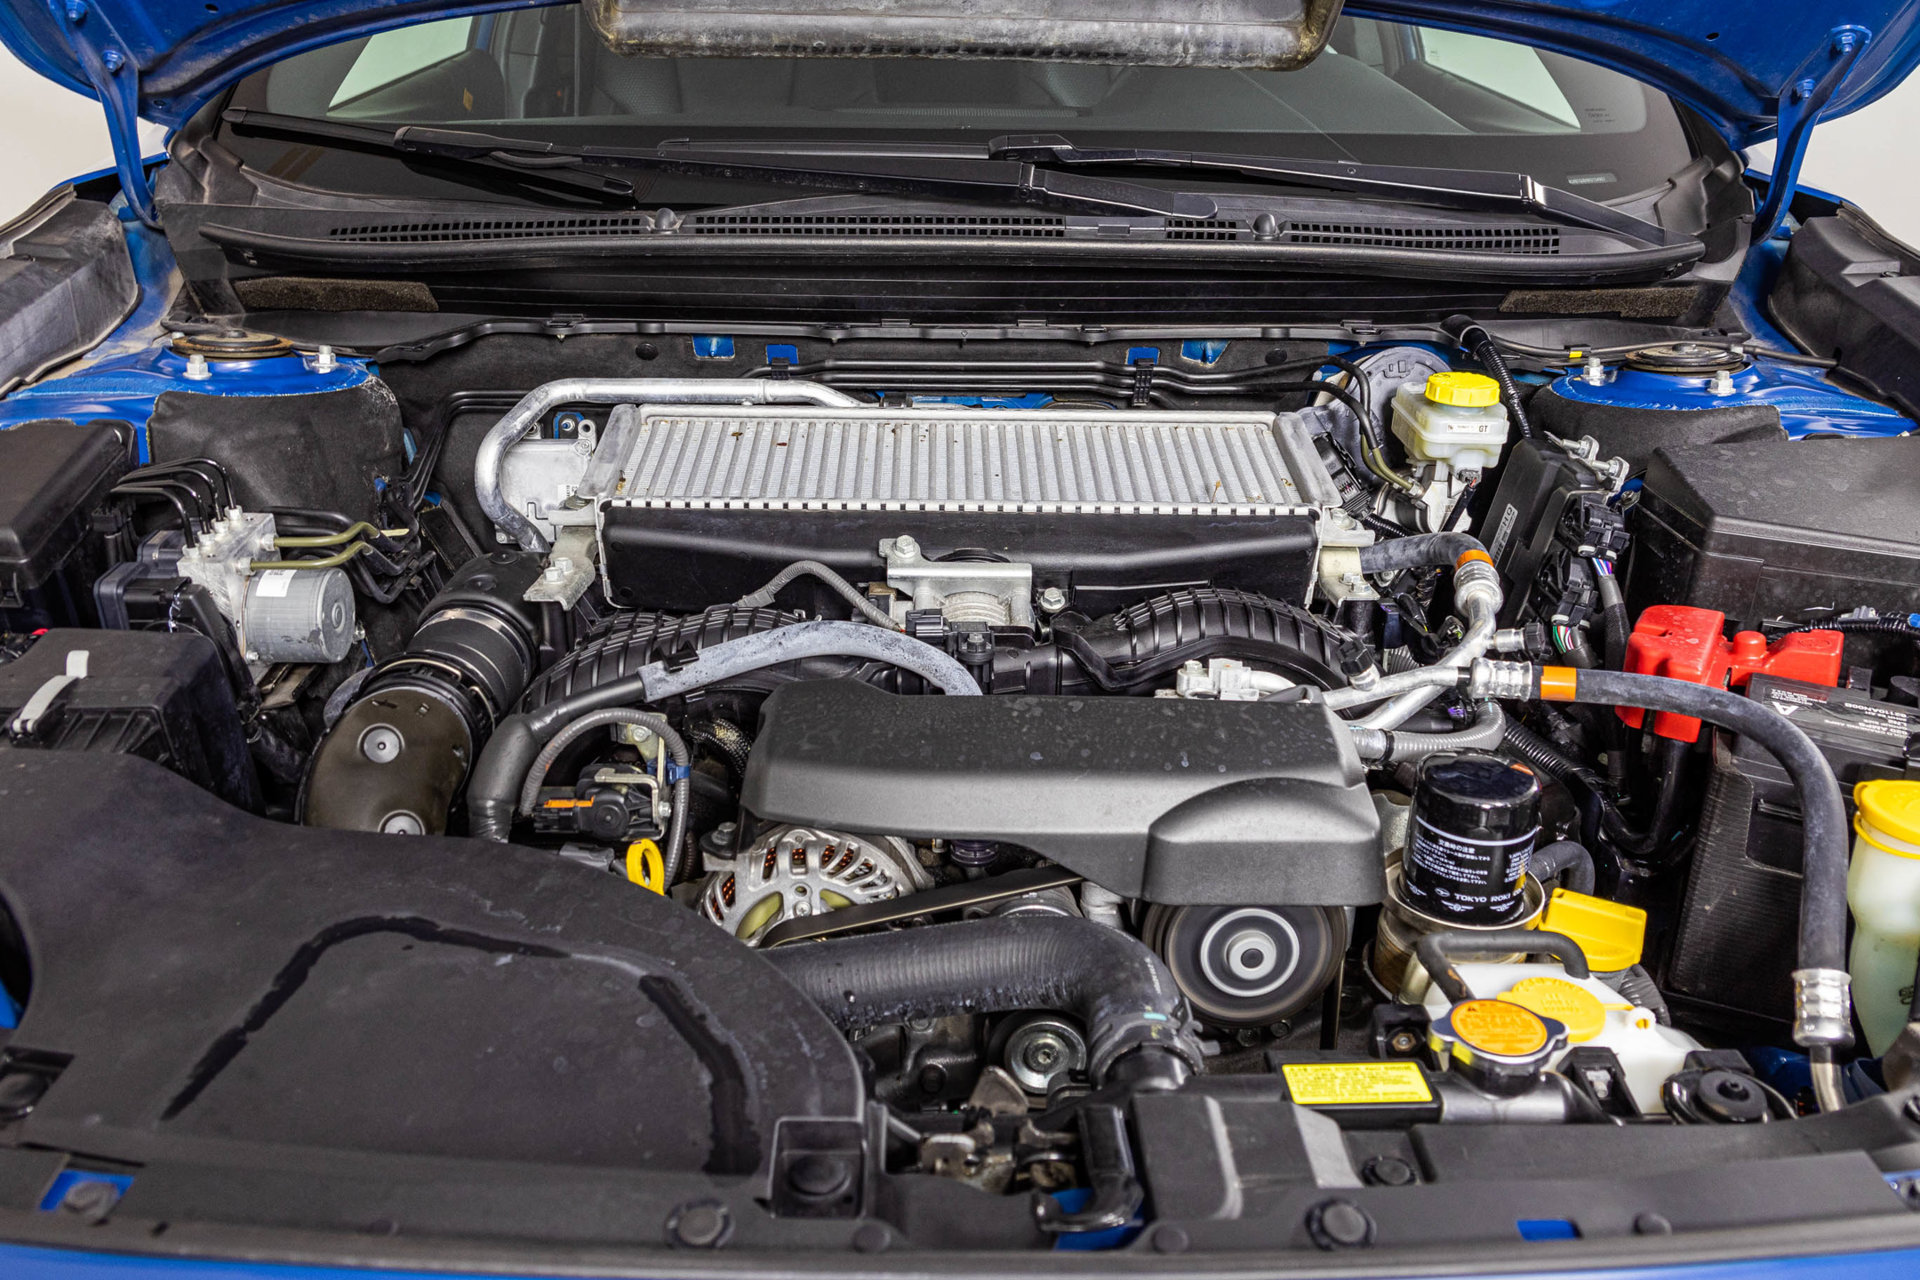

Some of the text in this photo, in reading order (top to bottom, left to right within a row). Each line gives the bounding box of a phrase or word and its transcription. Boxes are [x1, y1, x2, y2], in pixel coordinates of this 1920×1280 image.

[1478, 425, 1488, 433] GT
[1858, 721, 1888, 731] AMPS
[1454, 892, 1487, 903] TOKYO
[1490, 892, 1511, 902] ROKI
